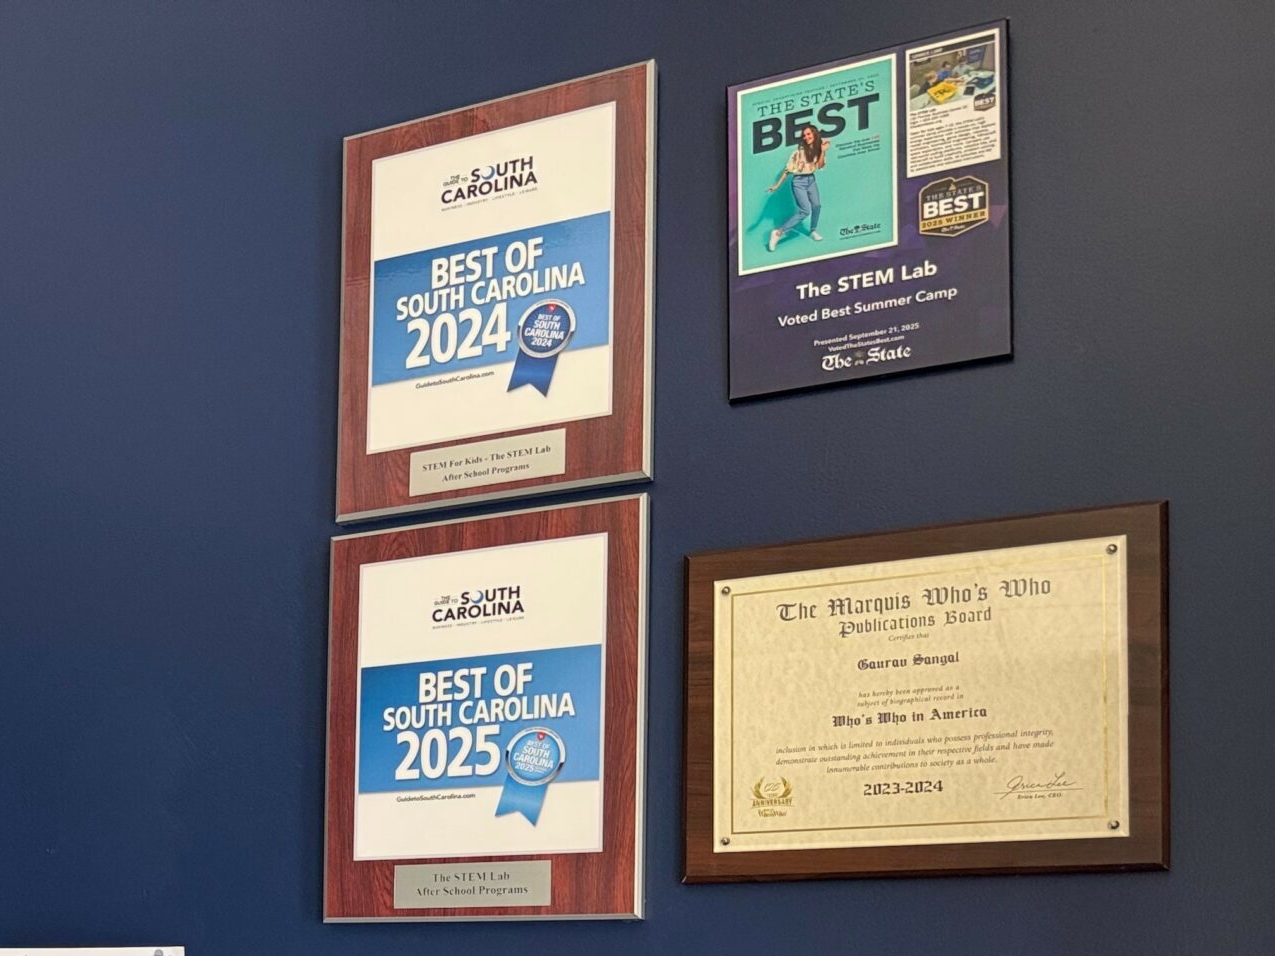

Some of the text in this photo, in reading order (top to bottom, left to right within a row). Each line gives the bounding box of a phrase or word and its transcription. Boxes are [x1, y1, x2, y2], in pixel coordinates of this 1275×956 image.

[757, 100, 794, 117] THE
[801, 80, 875, 108] STATE'S
[753, 93, 880, 155] BEST
[471, 156, 533, 183] SOUTH
[441, 171, 537, 204] CAROLINA
[431, 237, 543, 289] BEST OF
[397, 262, 585, 321] SOUTH CAROLINA
[796, 260, 938, 300] The STEM Lab
[778, 288, 958, 327] Voted Best Summer Camp
[405, 302, 511, 369] 2024
[813, 335, 847, 347] Presented
[849, 328, 887, 343] September
[901, 322, 920, 331] 2025
[821, 345, 912, 371] The State
[423, 462, 447, 471] STEM
[465, 456, 483, 465] Kids
[507, 448, 533, 458] STEM
[535, 445, 551, 454] Lab
[442, 464, 530, 482] After School Programs
[461, 586, 521, 605] SOUTH
[776, 578, 1051, 622] The Marquis Who's Who
[432, 600, 525, 622] CAROLINA
[839, 606, 992, 639] Publications Board
[913, 652, 959, 666] Sangal
[419, 662, 533, 703] BEST OF
[383, 692, 576, 731] SOUTH CAROLINA
[832, 708, 988, 728] Who's Who in America
[395, 725, 501, 781] 2025
[827, 757, 997, 773] innumerable contributions society whole.
[863, 780, 944, 796] 2023-2024
[417, 886, 528, 897] After School Programs
[433, 872, 510, 883] The STEM Lab
